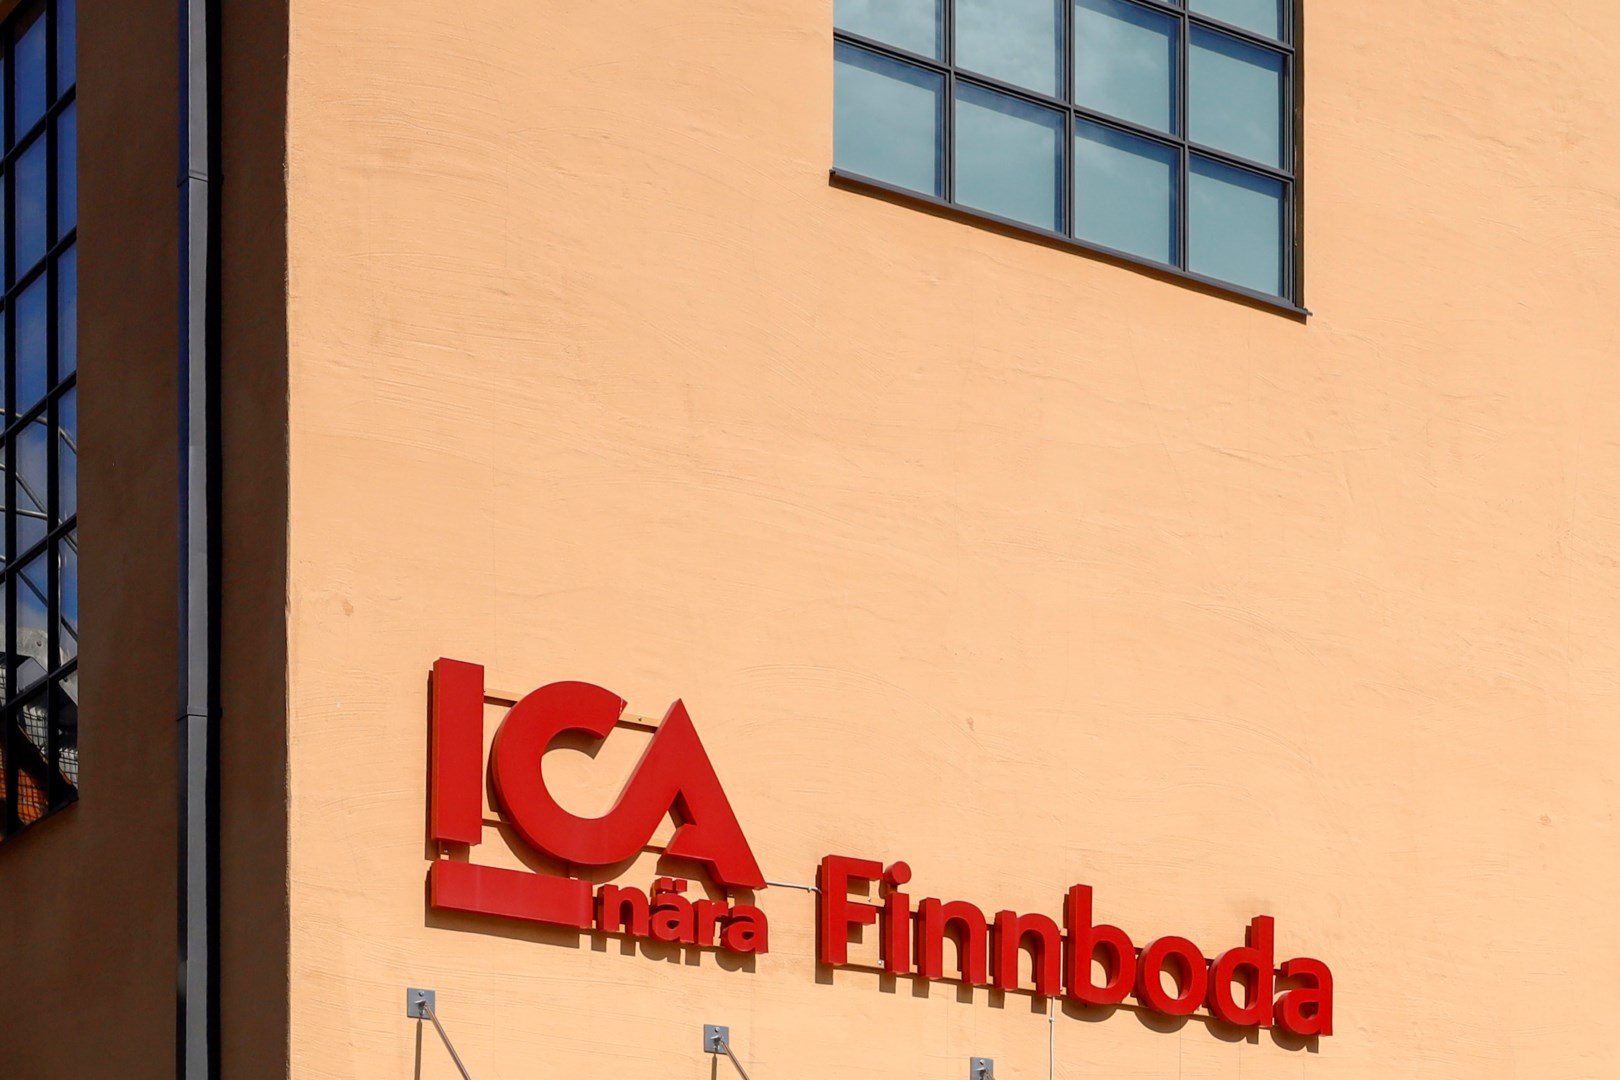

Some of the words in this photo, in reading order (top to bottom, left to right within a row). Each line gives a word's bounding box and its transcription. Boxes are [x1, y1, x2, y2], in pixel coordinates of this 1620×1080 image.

[432, 657, 767, 889] ICA
[601, 878, 768, 955] nära
[820, 854, 1333, 1037] Finnboda
